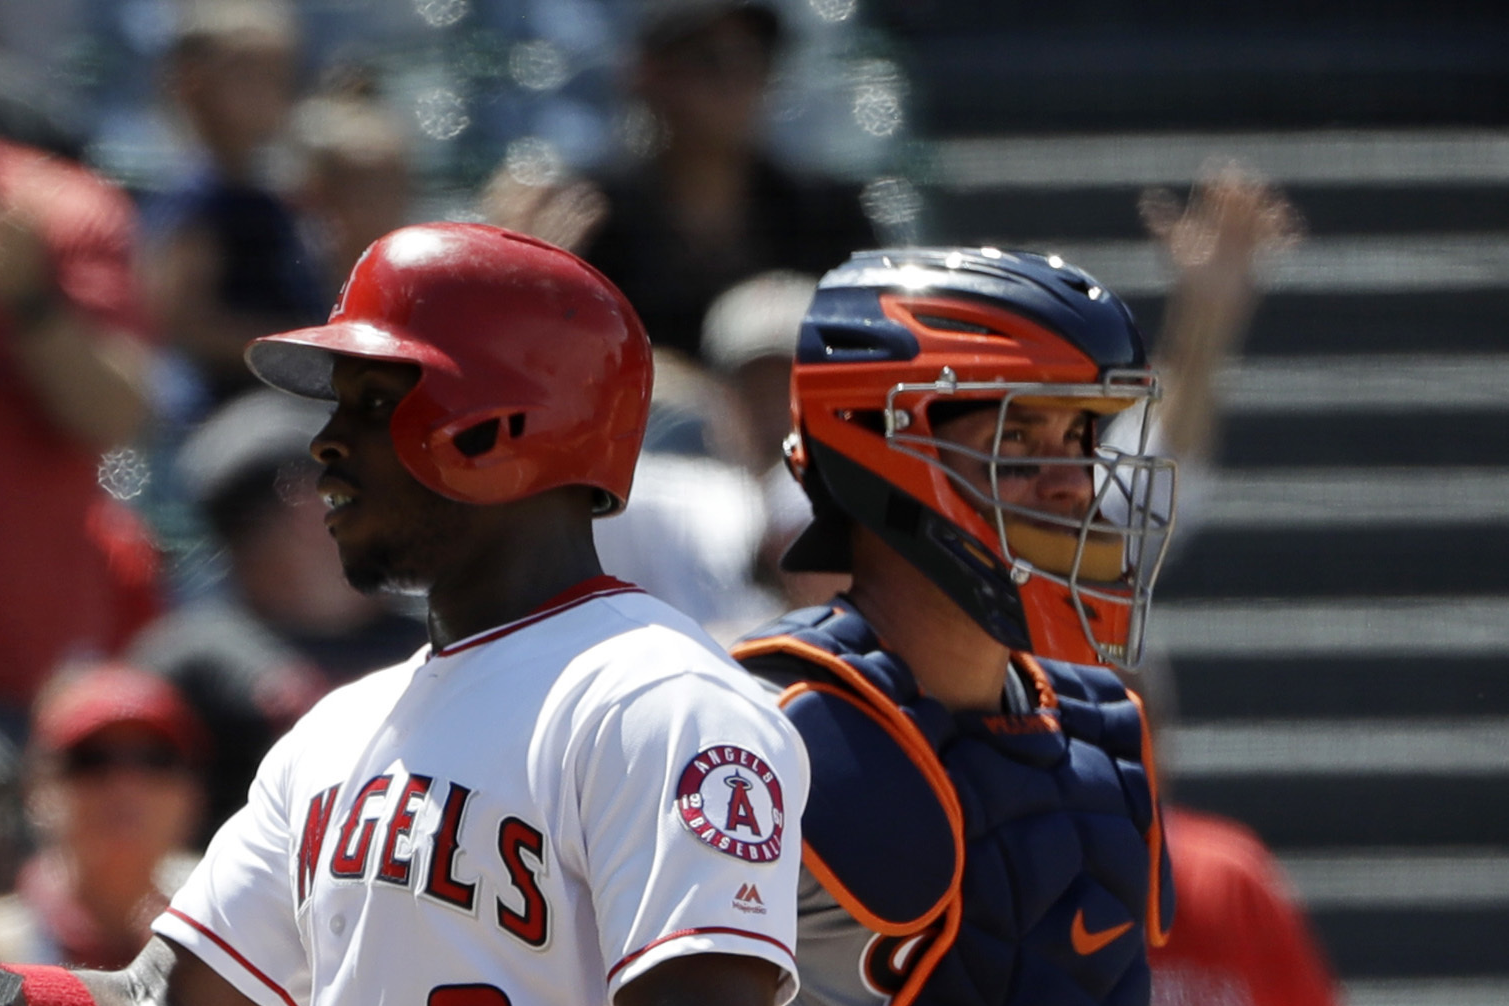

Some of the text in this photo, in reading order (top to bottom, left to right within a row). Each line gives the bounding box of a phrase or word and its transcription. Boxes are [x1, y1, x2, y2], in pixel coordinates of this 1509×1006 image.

[693, 746, 774, 783] ANGELS
[724, 768, 762, 838] A
[295, 772, 550, 949] NGELS
[689, 816, 782, 861] BASEBALL
